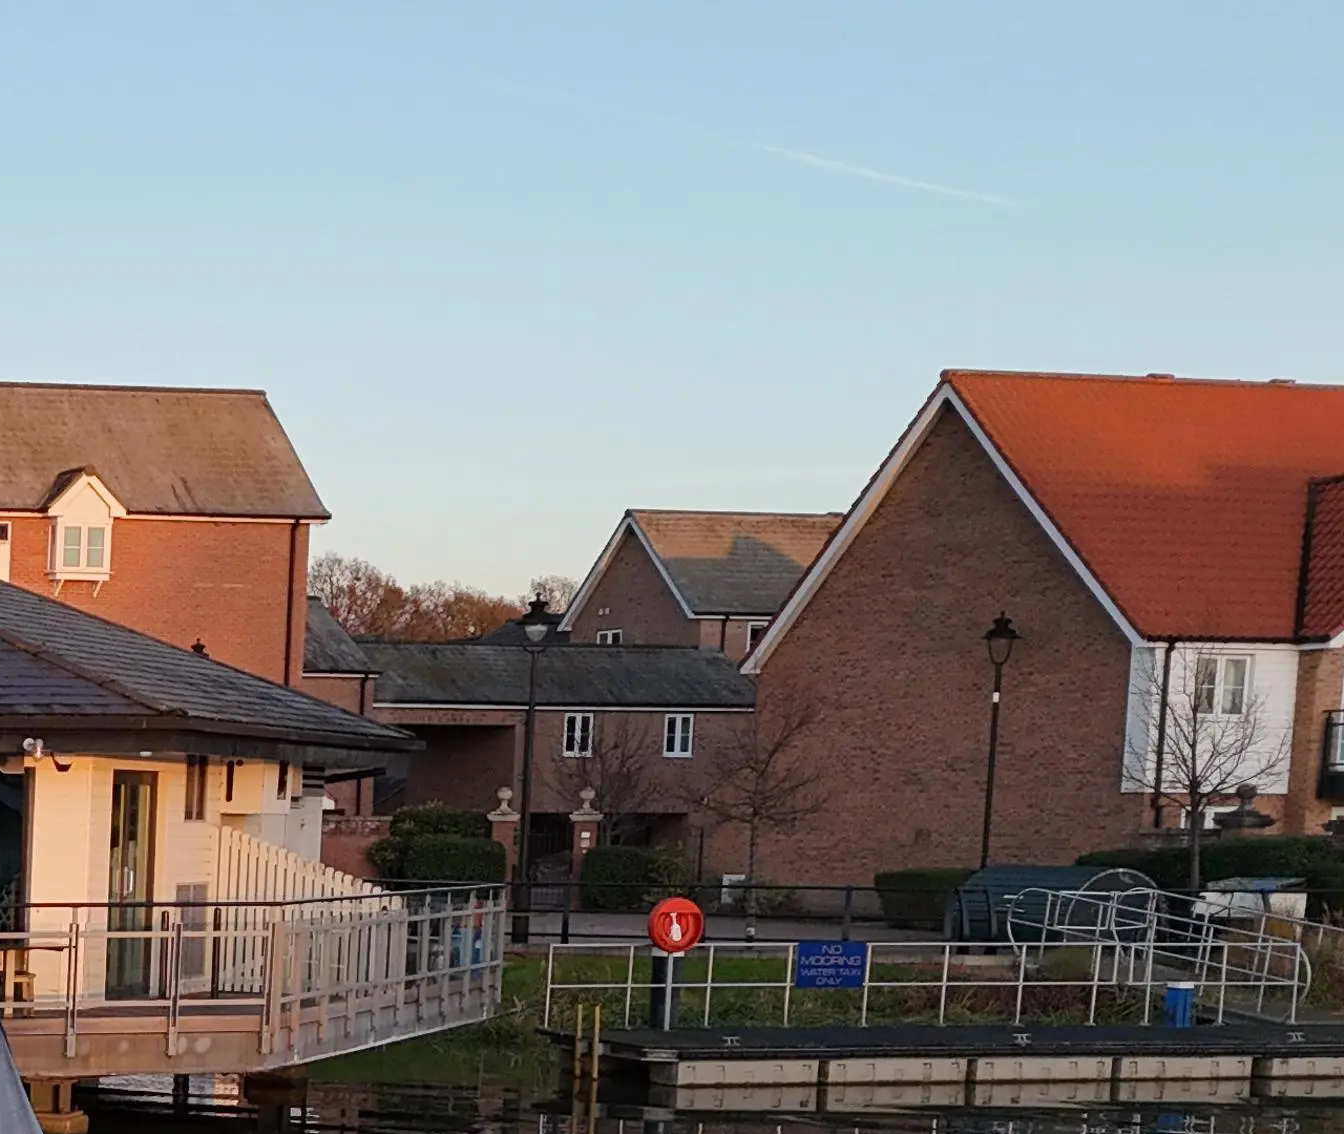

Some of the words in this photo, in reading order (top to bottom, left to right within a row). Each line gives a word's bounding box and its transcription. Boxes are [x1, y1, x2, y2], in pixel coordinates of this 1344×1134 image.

[821, 944, 842, 954] NO
[800, 955, 861, 966] MOORING
[800, 968, 836, 976] WATER
[816, 976, 843, 985] ONLY
